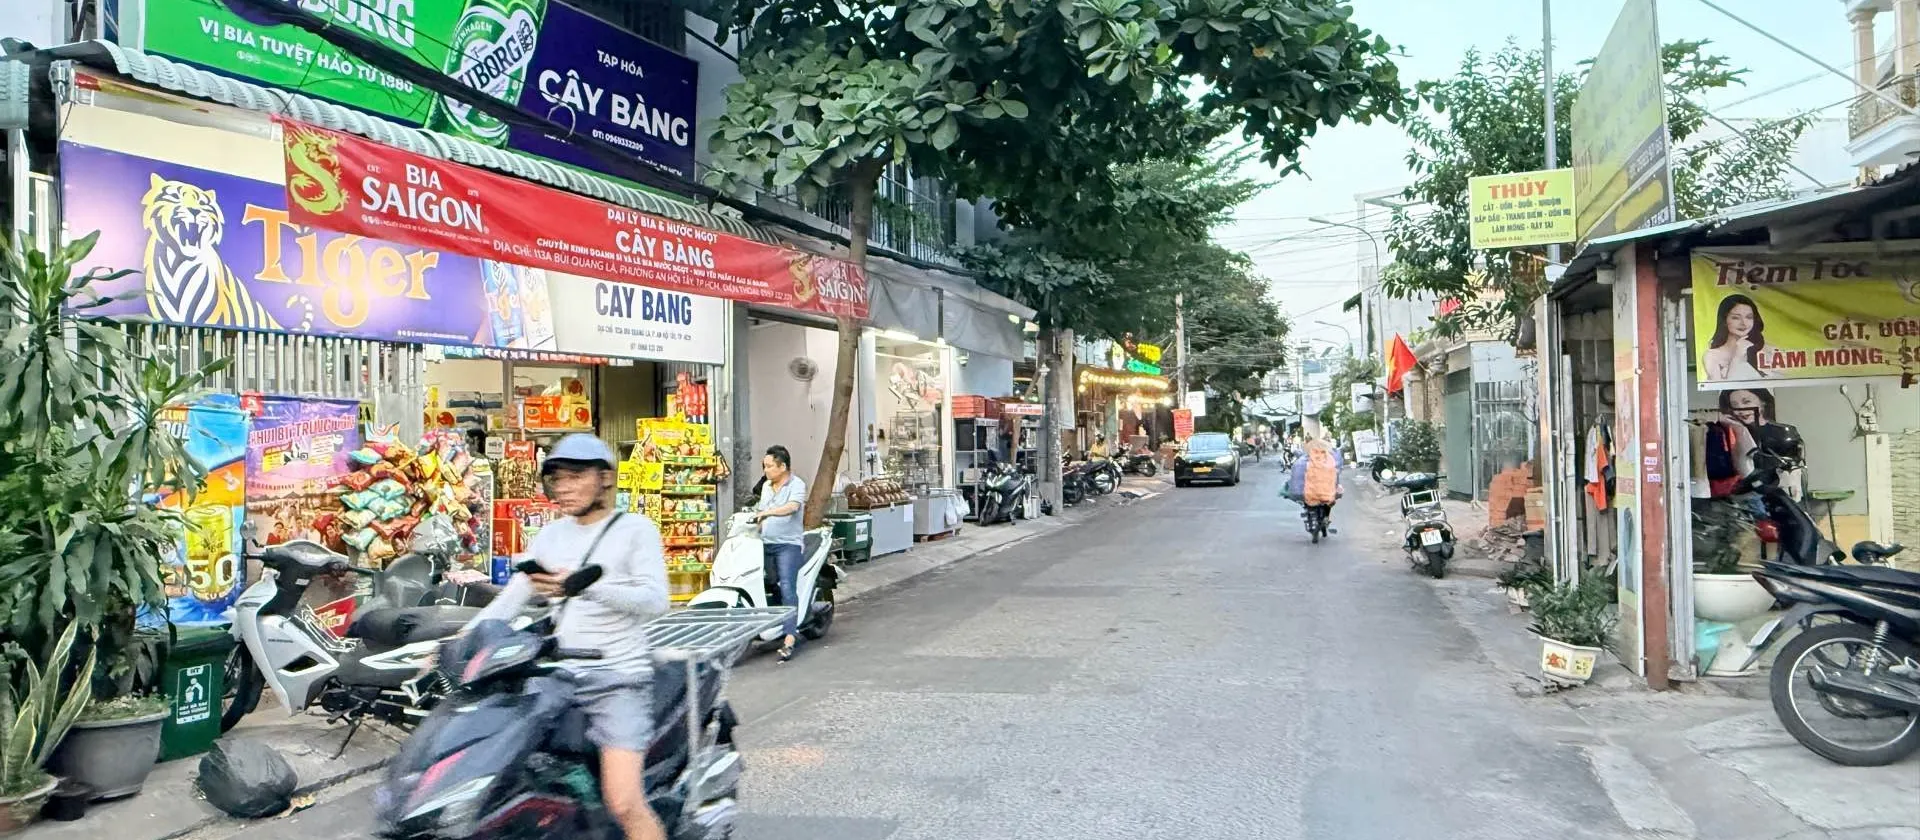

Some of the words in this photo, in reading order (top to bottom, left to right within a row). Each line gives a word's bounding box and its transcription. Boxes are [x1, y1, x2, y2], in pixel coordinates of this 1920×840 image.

[198, 16, 219, 42] VỊ
[224, 24, 256, 48] BIA
[260, 35, 315, 66] TUYỆT
[317, 51, 353, 75] HẢO
[458, 33, 524, 90] UBORG
[597, 49, 618, 68] TẠP
[621, 56, 644, 78] HÓA
[539, 69, 604, 117] CÂY
[611, 93, 689, 146] BÀNG
[406, 163, 443, 191] BIA
[1488, 177, 1548, 199] THỦY
[361, 176, 483, 233] SAIGON
[608, 208, 625, 224] ĐẠI
[628, 211, 638, 225] LÝ
[641, 217, 656, 229] BIA
[667, 223, 693, 238] NƯỚC
[695, 229, 718, 245] NGỌT
[537, 237, 569, 252] CHUYÊN
[615, 228, 656, 258] CÂY
[662, 237, 715, 268] BÀNG
[241, 203, 440, 329] Tiger
[571, 255, 604, 271] QUANG
[1715, 260, 1798, 290] Tiệm
[1758, 348, 1806, 369] LÀM
